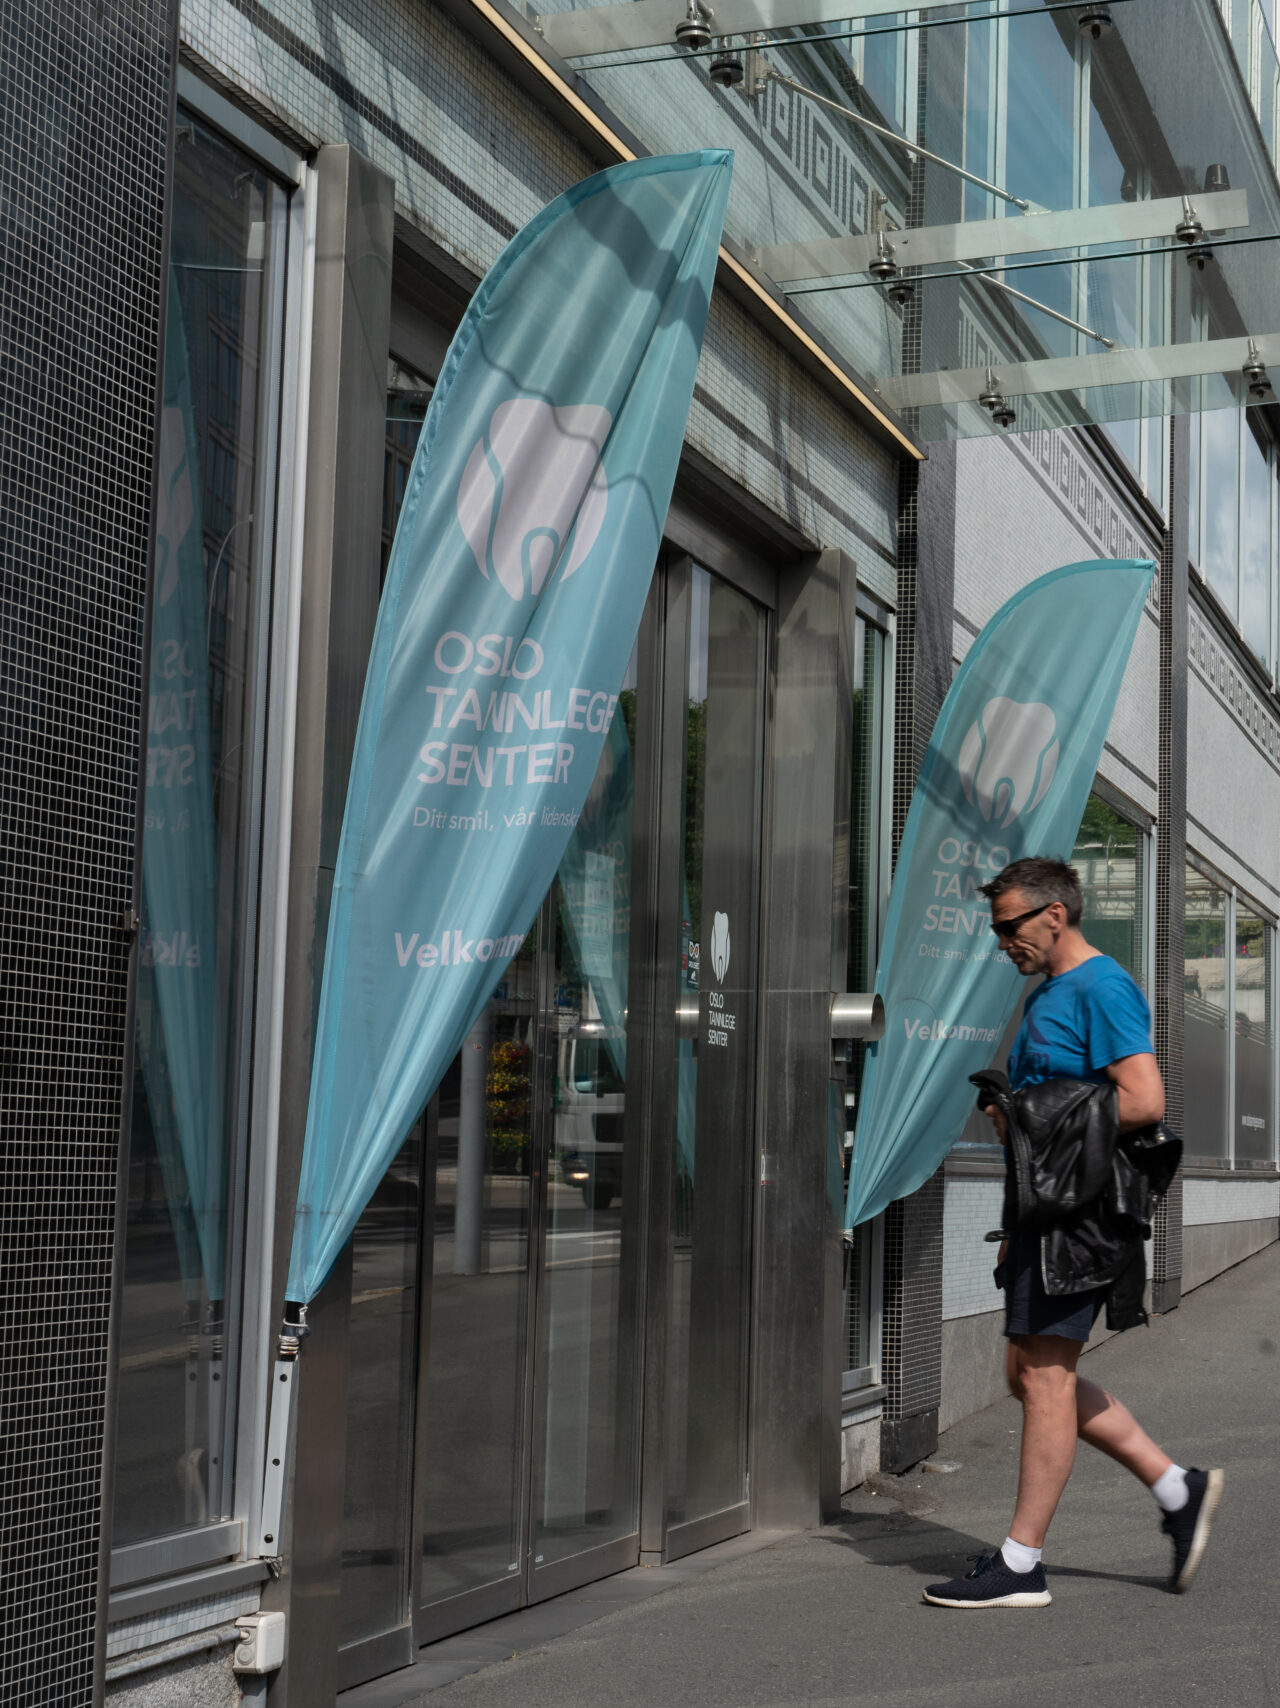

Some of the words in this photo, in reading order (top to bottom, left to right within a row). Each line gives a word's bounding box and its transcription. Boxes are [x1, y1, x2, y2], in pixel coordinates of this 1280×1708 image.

[434, 631, 544, 680] OSLO
[417, 741, 575, 787] SENTER
[413, 806, 446, 828] Ditt
[449, 809, 494, 831] smil,
[504, 806, 536, 828] vår
[540, 805, 580, 827] lidensk
[938, 837, 1010, 872] OSLO
[923, 904, 995, 937] SENT
[709, 991, 724, 1009] OSLO
[708, 1010, 736, 1030] TANNLEGE
[708, 1029, 728, 1047] SENTER
